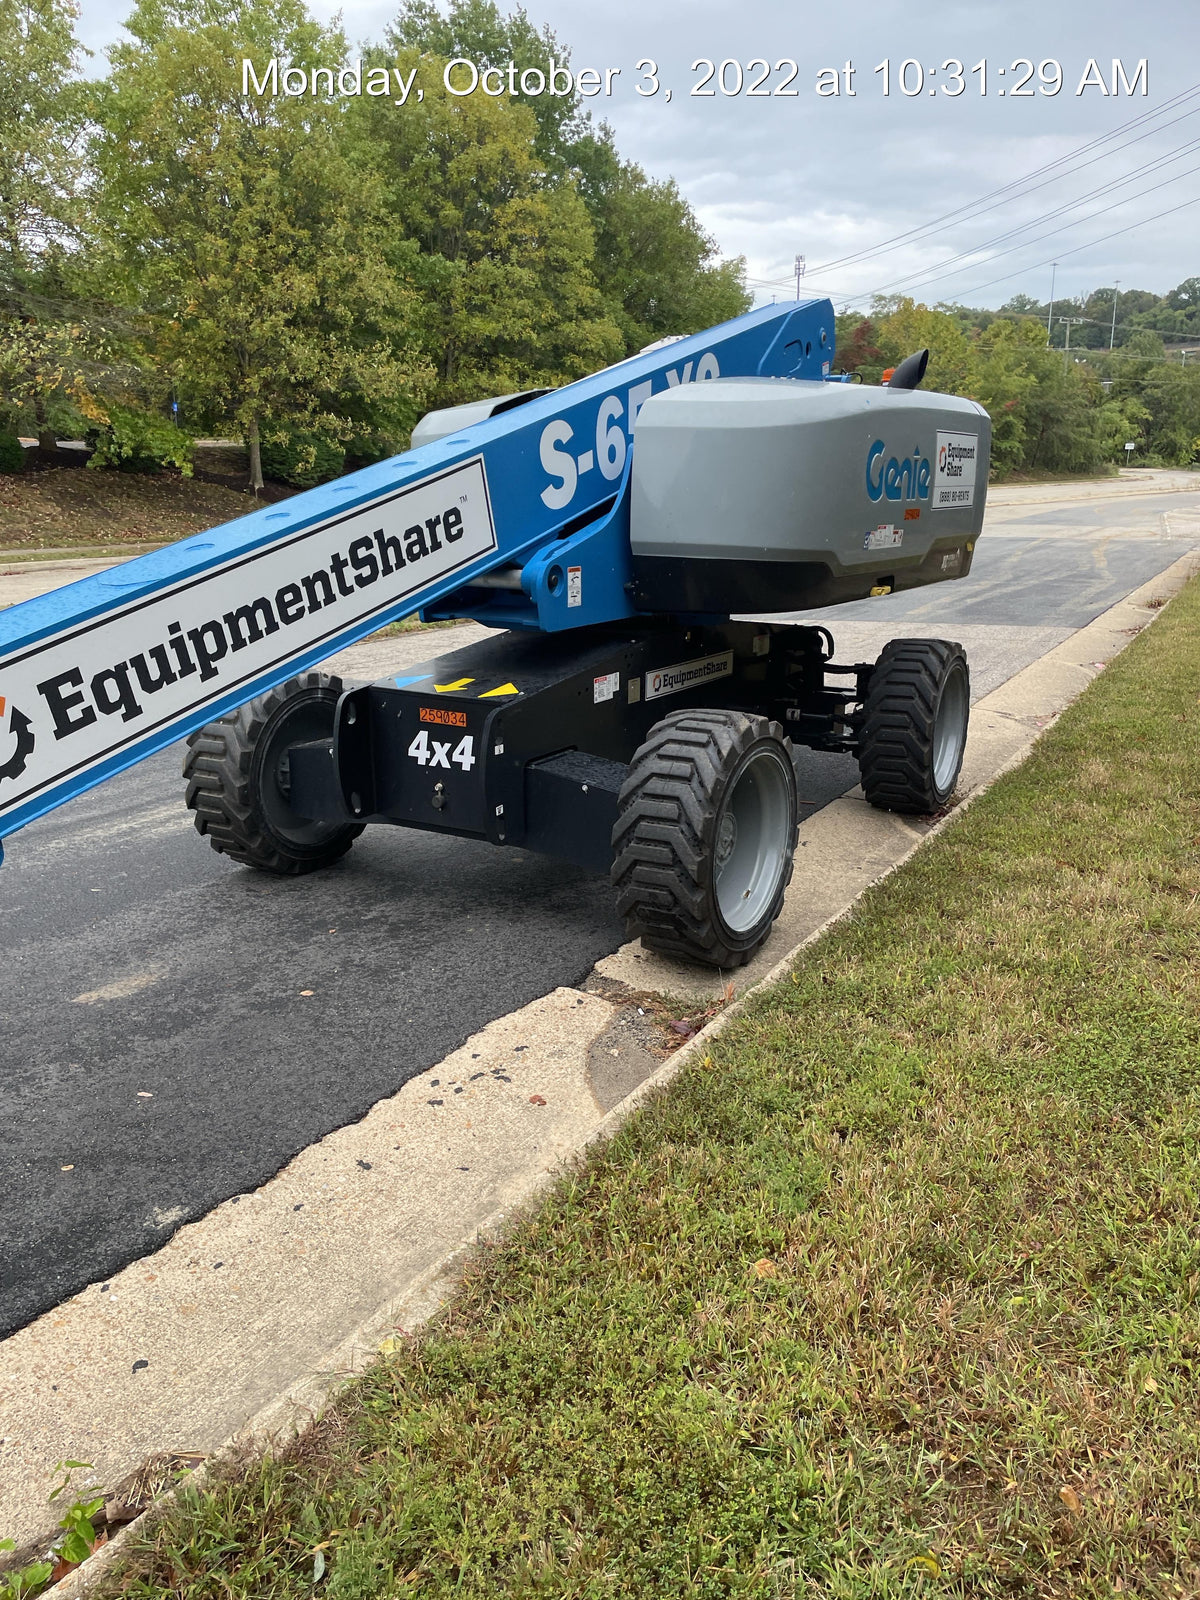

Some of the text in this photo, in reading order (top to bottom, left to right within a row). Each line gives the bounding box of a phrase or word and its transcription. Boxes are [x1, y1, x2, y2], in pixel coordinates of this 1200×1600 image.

[947, 443, 975, 462] Equipment
[866, 439, 931, 503] Genie
[946, 461, 963, 477] Share
[36, 505, 465, 741] EquipmentShare
[662, 659, 728, 689] EquipmentShare
[420, 708, 467, 726] 259034
[407, 730, 476, 772] 4x4
